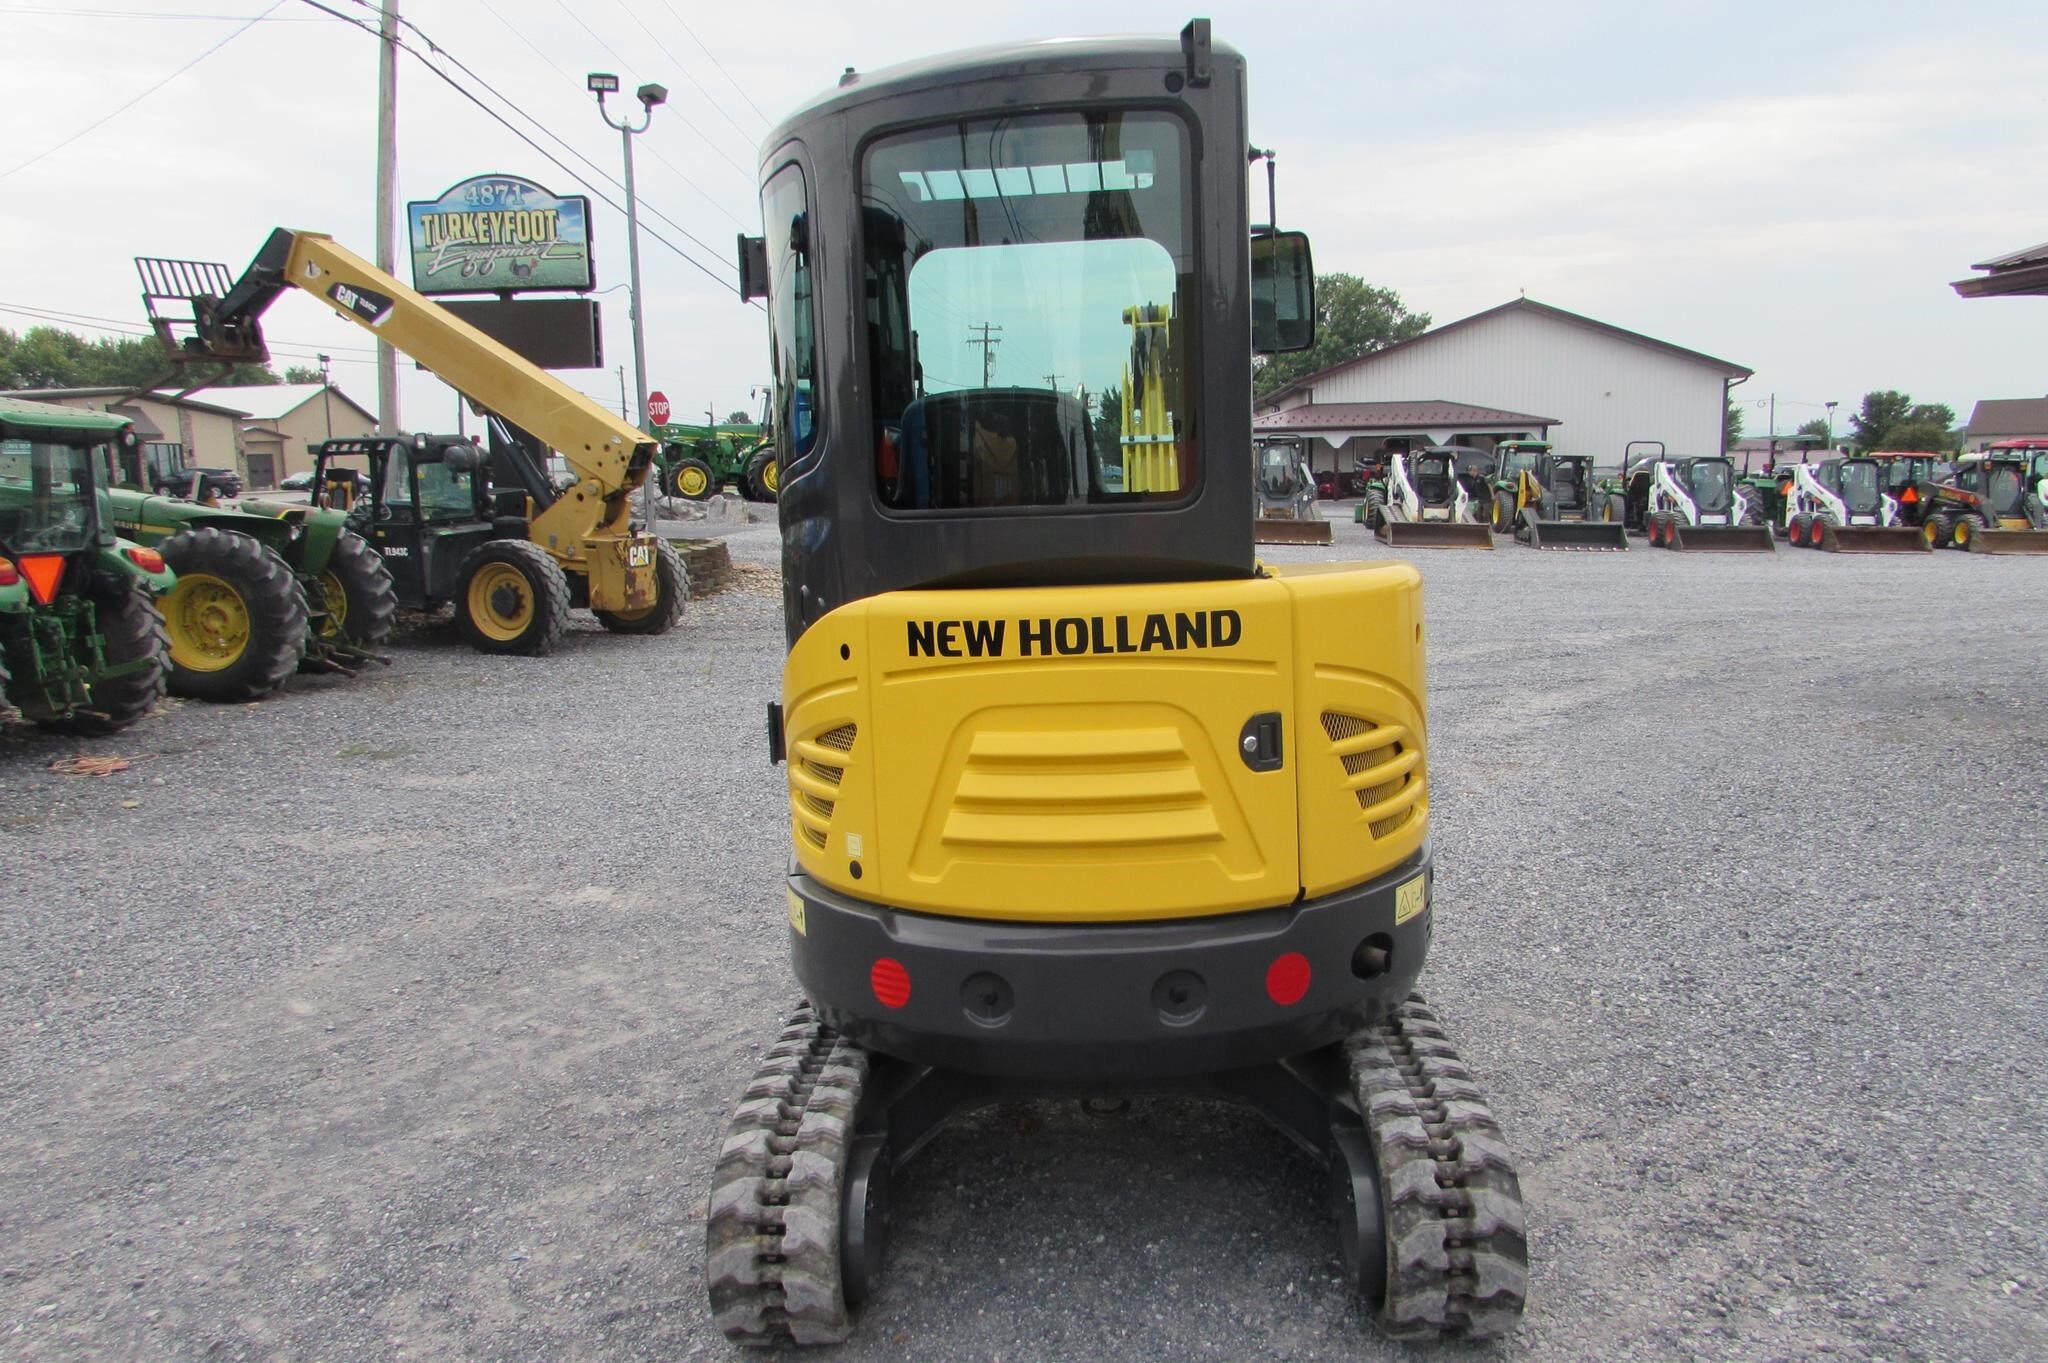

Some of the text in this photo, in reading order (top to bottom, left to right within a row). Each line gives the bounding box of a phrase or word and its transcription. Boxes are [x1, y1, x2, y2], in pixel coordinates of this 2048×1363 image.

[465, 184, 525, 206] 4871
[421, 209, 561, 247] TURKEYFOOT
[427, 235, 583, 278] Equipment
[336, 284, 359, 310] CAT
[649, 402, 669, 416] STOP
[629, 545, 649, 567] CAT
[907, 609, 1242, 657] NEW HOLLAND
